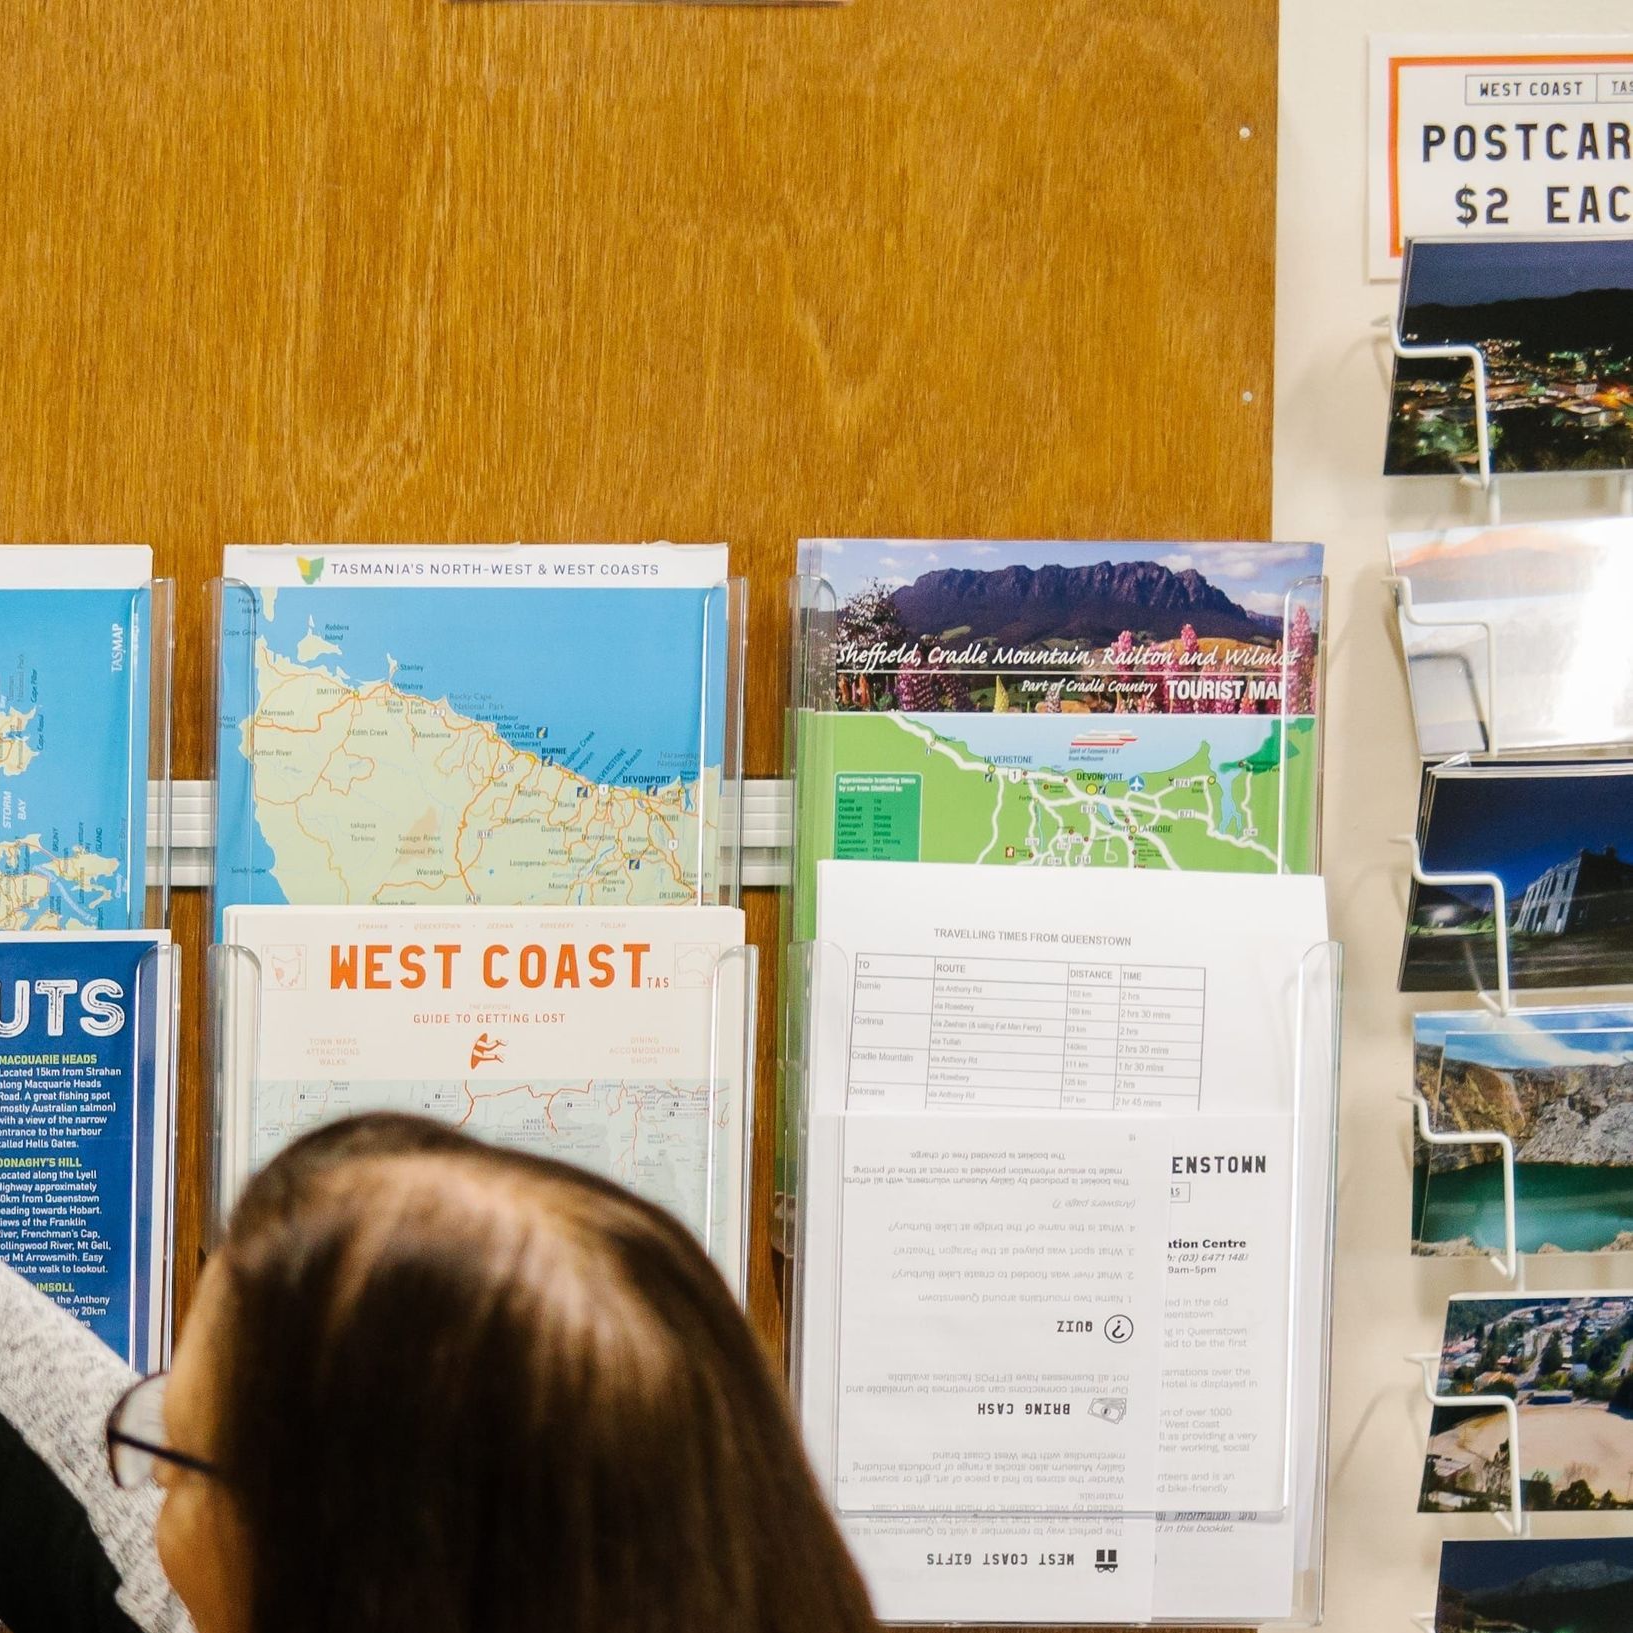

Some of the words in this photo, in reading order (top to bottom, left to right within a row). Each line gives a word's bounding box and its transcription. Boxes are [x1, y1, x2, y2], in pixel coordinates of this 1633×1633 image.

[1480, 82, 1522, 96] WEST
[1530, 81, 1582, 96] COAST
[1422, 122, 1633, 162] POSTCAR
[1455, 183, 1509, 228] $2
[1547, 186, 1633, 223] EAC
[332, 564, 424, 576] TASMANIA'S
[430, 563, 532, 576] NORTH-WEST
[538, 564, 548, 575] &
[554, 564, 595, 576] WEST
[600, 564, 658, 576] COASTS
[111, 623, 124, 672] TASMAP
[836, 642, 922, 673] Sheffield,
[928, 644, 987, 665] Cradle
[992, 645, 1094, 667] Mountain,
[1102, 644, 1174, 667] Railton
[1178, 646, 1217, 665] and
[1167, 680, 1243, 700] TOURIST
[330, 944, 461, 990] WEST
[483, 943, 650, 989] COAST
[647, 977, 670, 989] TAS
[413, 1014, 450, 1024] GUIDE
[455, 1014, 470, 1024] TO
[477, 1014, 529, 1024] GETTING
[535, 1013, 565, 1023] LOST
[61, 1054, 97, 1064] HEADS
[26, 1139, 50, 1148] Hells
[51, 1139, 79, 1149] Gates.
[1057, 1320, 1093, 1333] QUIZ
[977, 1402, 1013, 1415] CASH
[1025, 1403, 1071, 1416] BRING
[926, 1553, 972, 1565] GIFTS
[982, 1553, 1028, 1565] COAST
[1038, 1553, 1075, 1566] WEST
